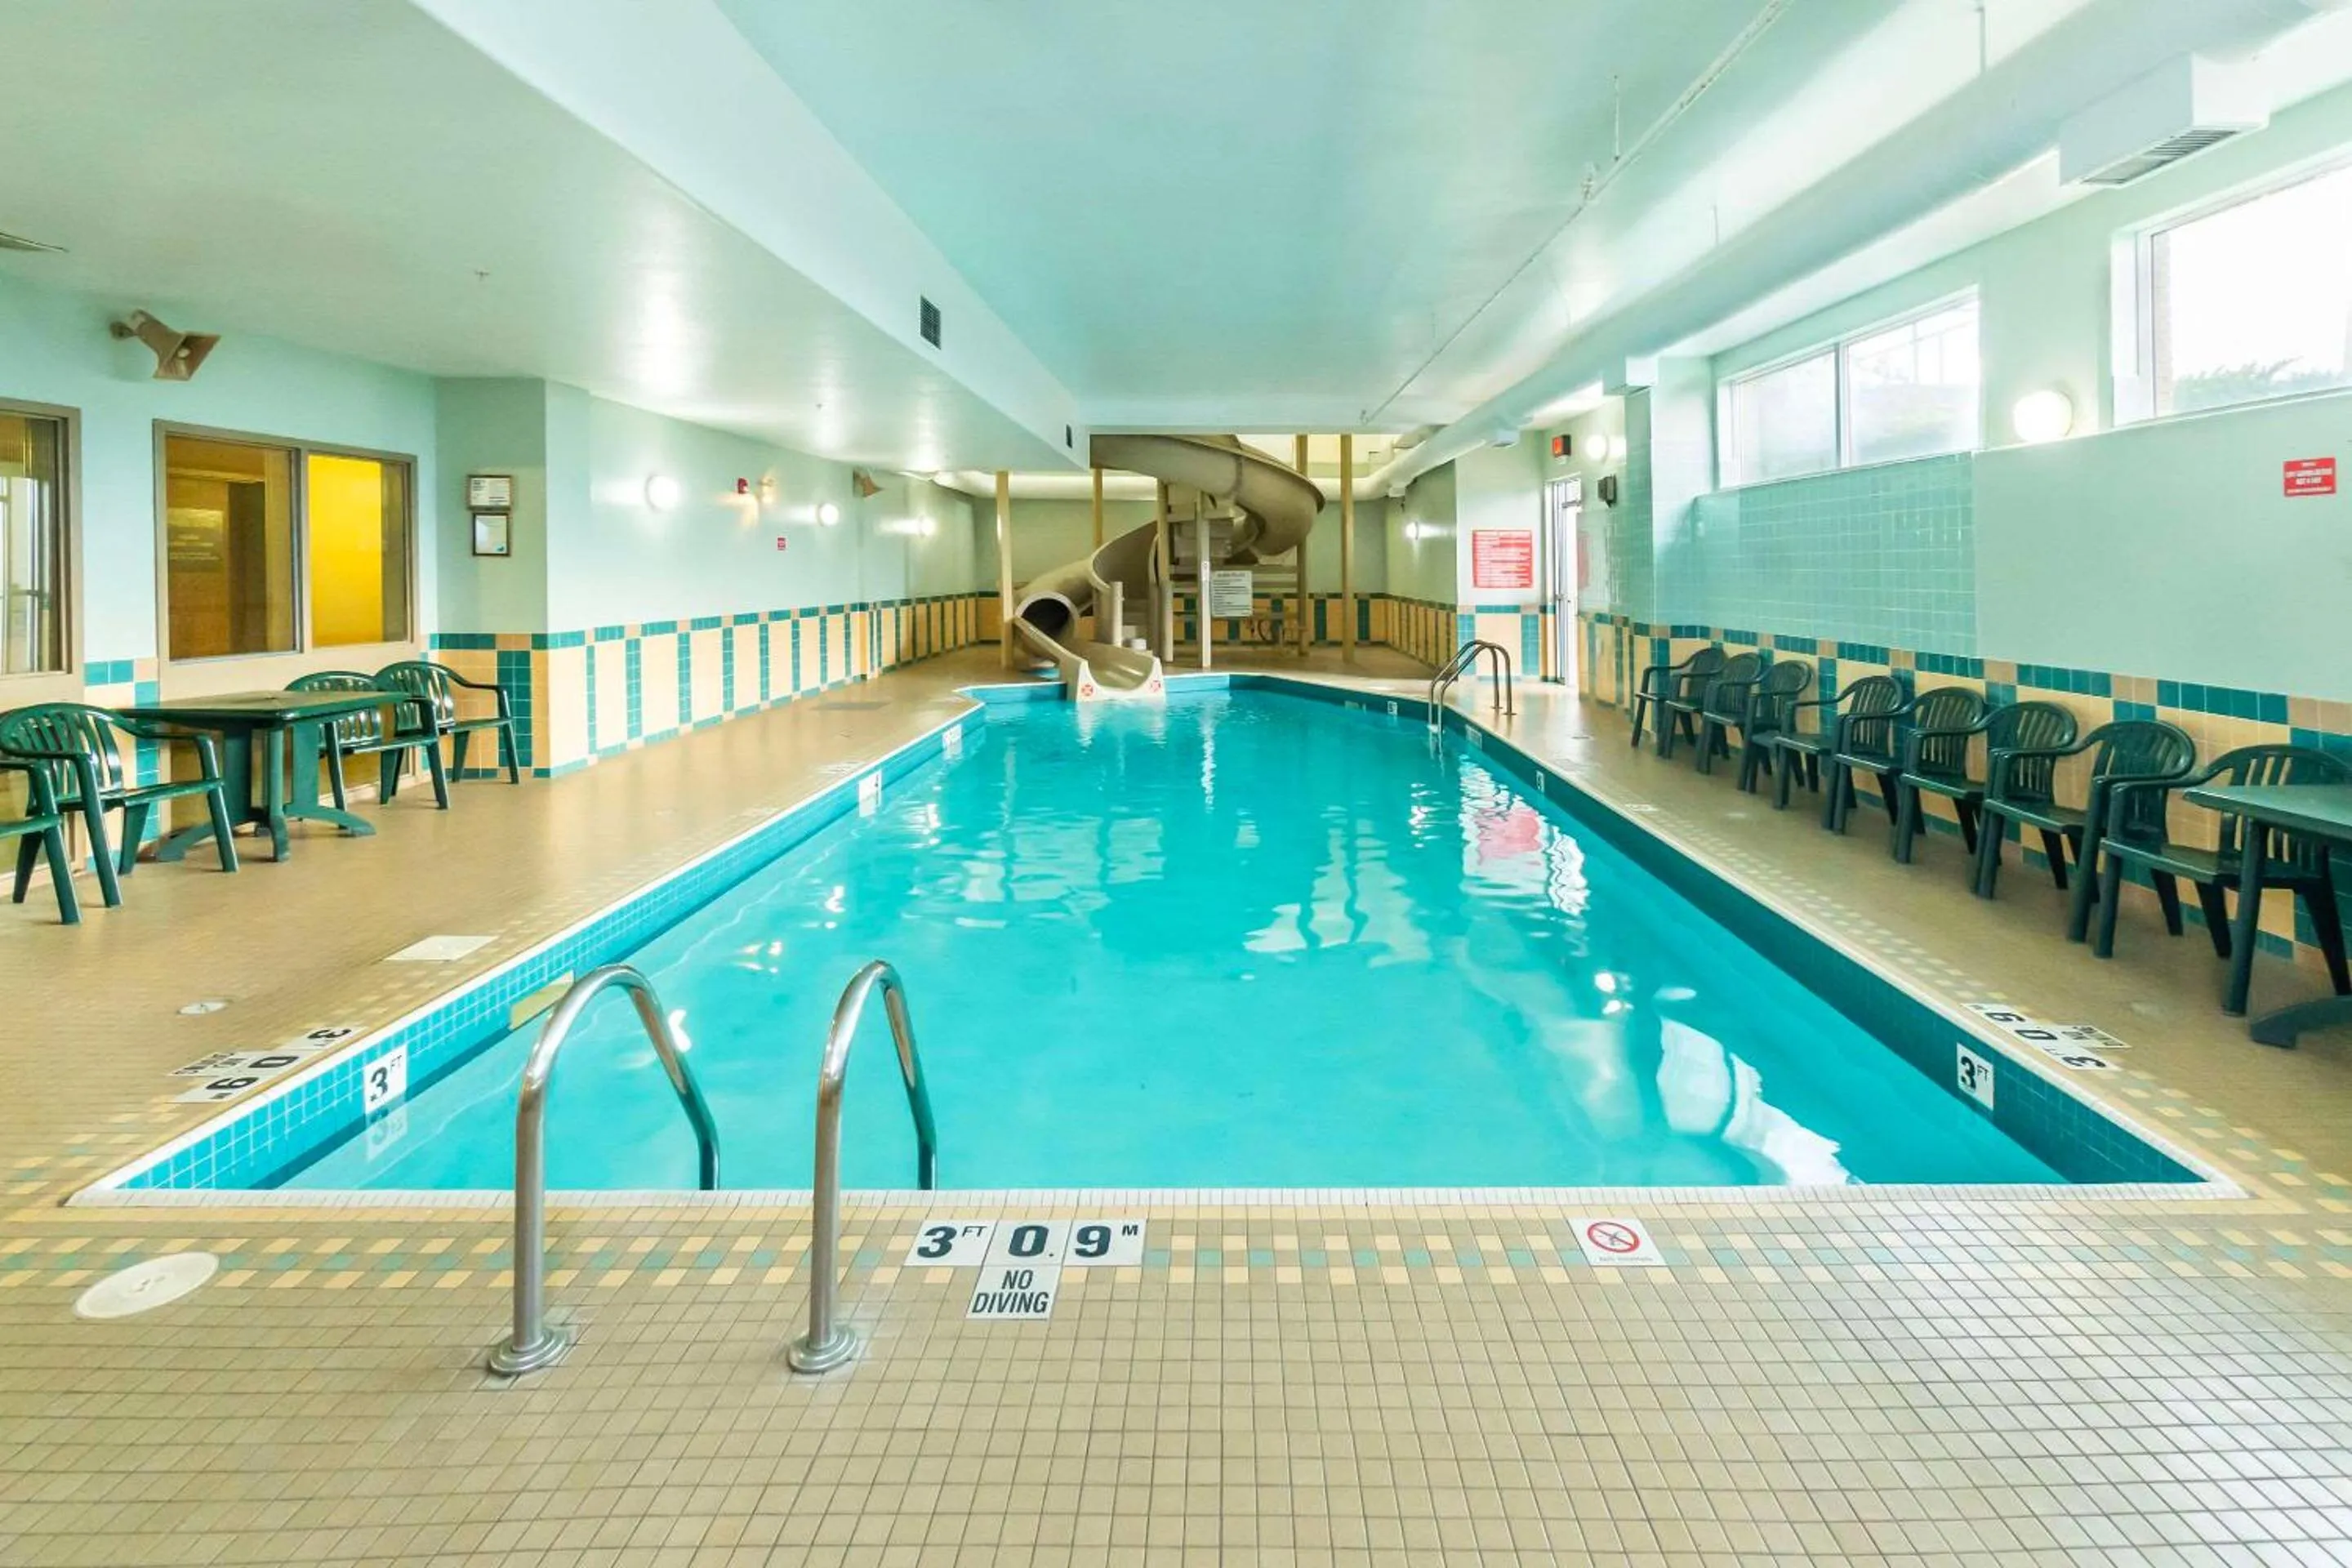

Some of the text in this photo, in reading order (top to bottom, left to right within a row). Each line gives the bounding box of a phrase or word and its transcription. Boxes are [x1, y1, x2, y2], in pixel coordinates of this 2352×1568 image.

[1961, 1056, 1976, 1089] 3
[2062, 1056, 2106, 1067] 3
[370, 1067, 388, 1102] 3
[917, 1226, 957, 1258] 3
[961, 1226, 987, 1237] FT
[1121, 1225, 1138, 1236] M
[1001, 1270, 1034, 1289] NO
[972, 1292, 1049, 1313] DIVING
